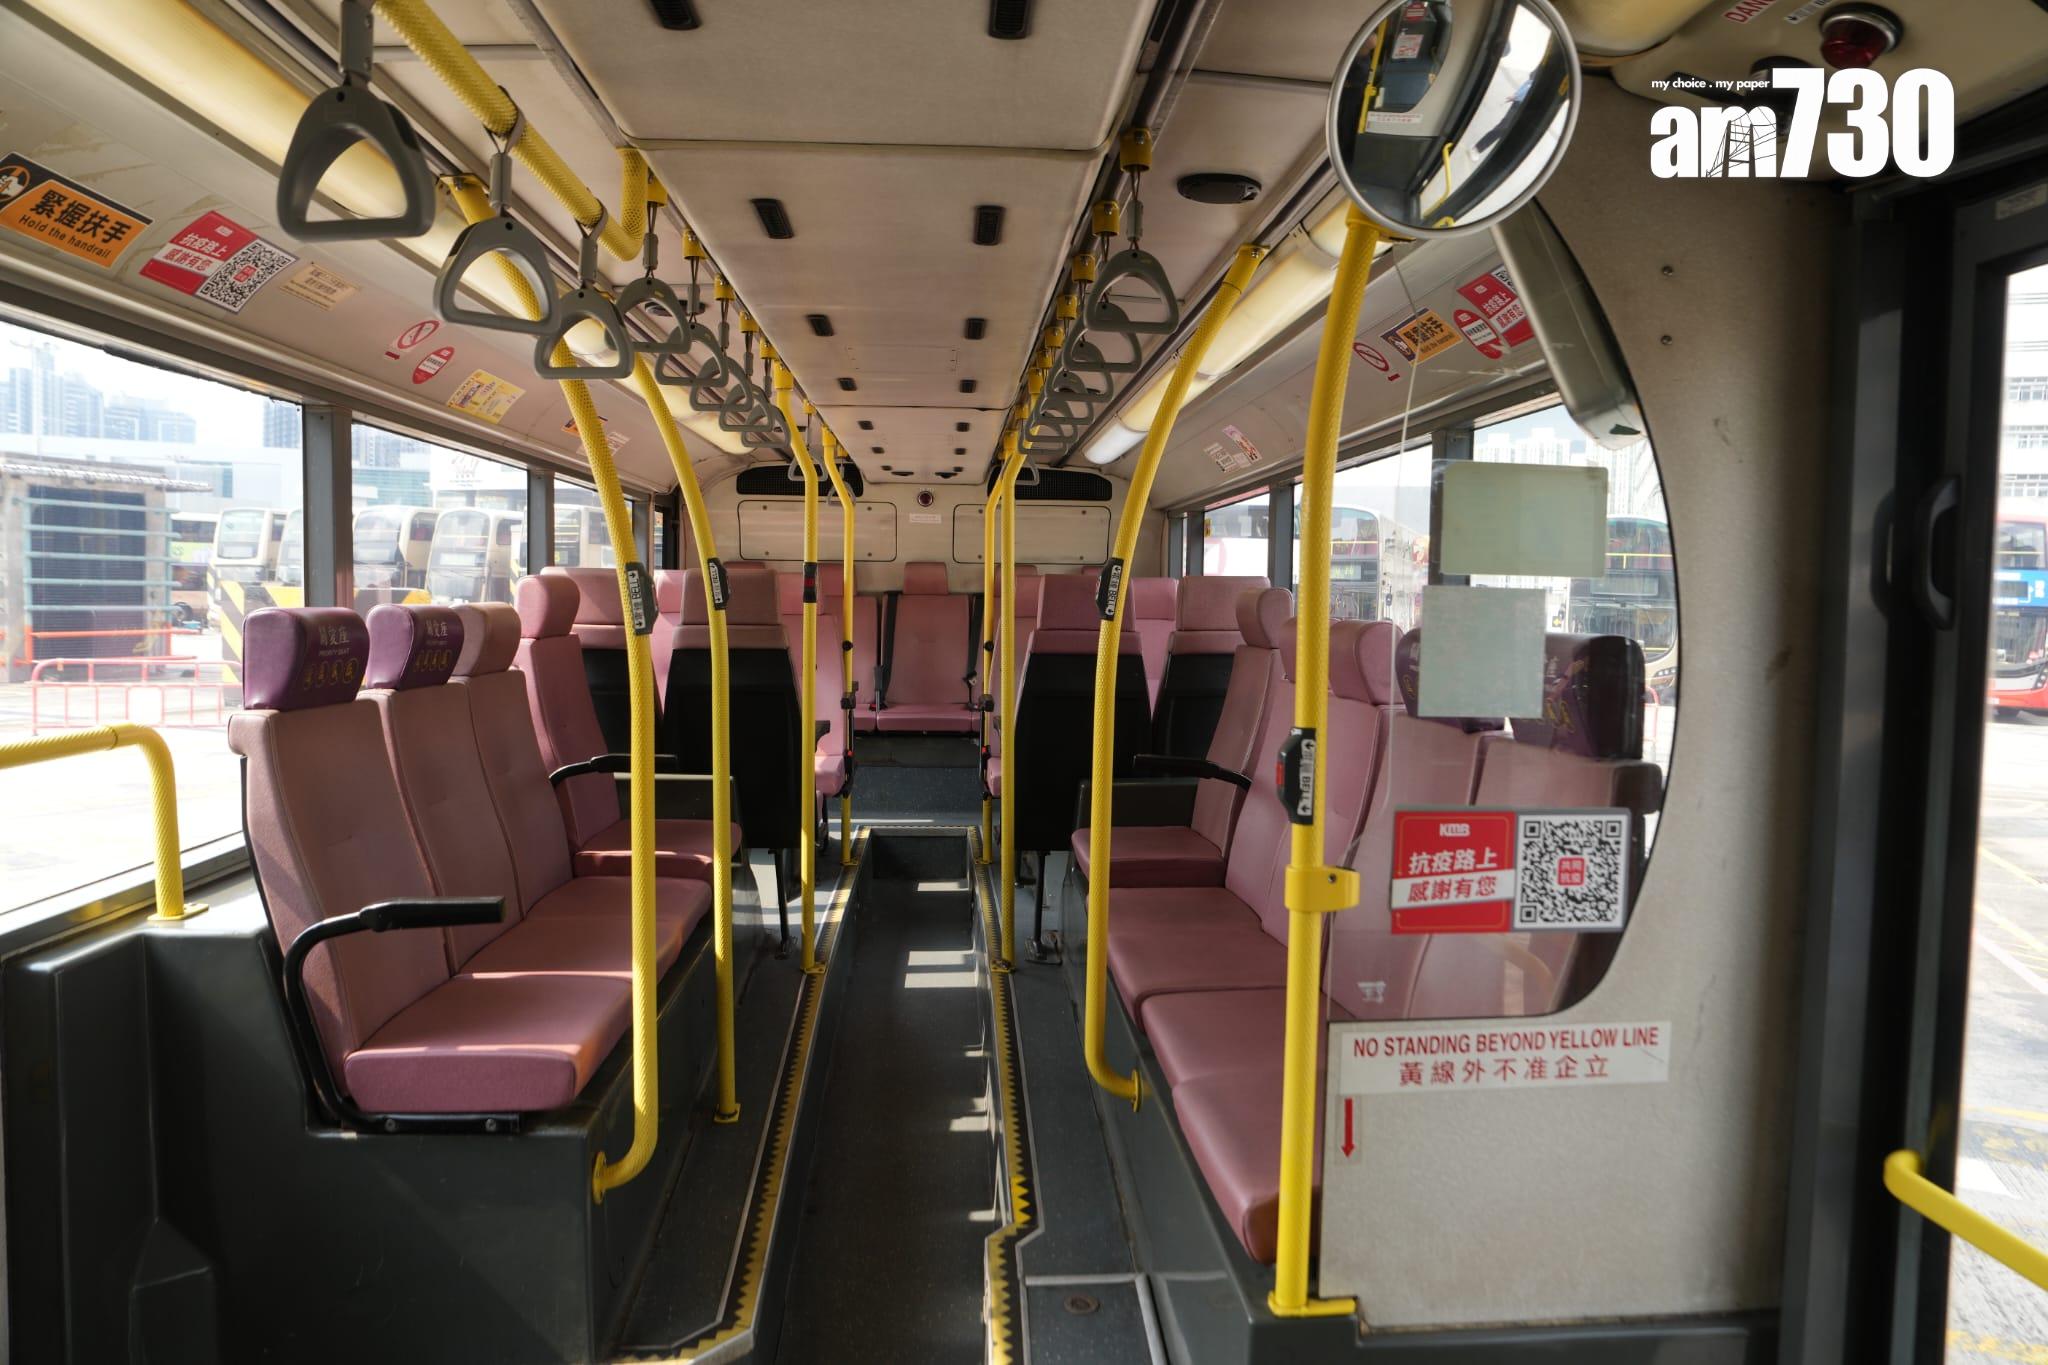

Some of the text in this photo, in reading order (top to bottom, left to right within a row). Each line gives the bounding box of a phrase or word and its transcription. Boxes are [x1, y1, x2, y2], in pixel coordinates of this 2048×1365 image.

[1724, 0, 1774, 22] DAN
[29, 188, 133, 245] 緊握扶手
[18, 213, 112, 259] Hold the handrail
[1408, 847, 1498, 875] 抗疫路上
[1407, 875, 1498, 903] 感謝有您
[1354, 1026, 1659, 1058] NO STANDING BEYOND YELLOW LINE
